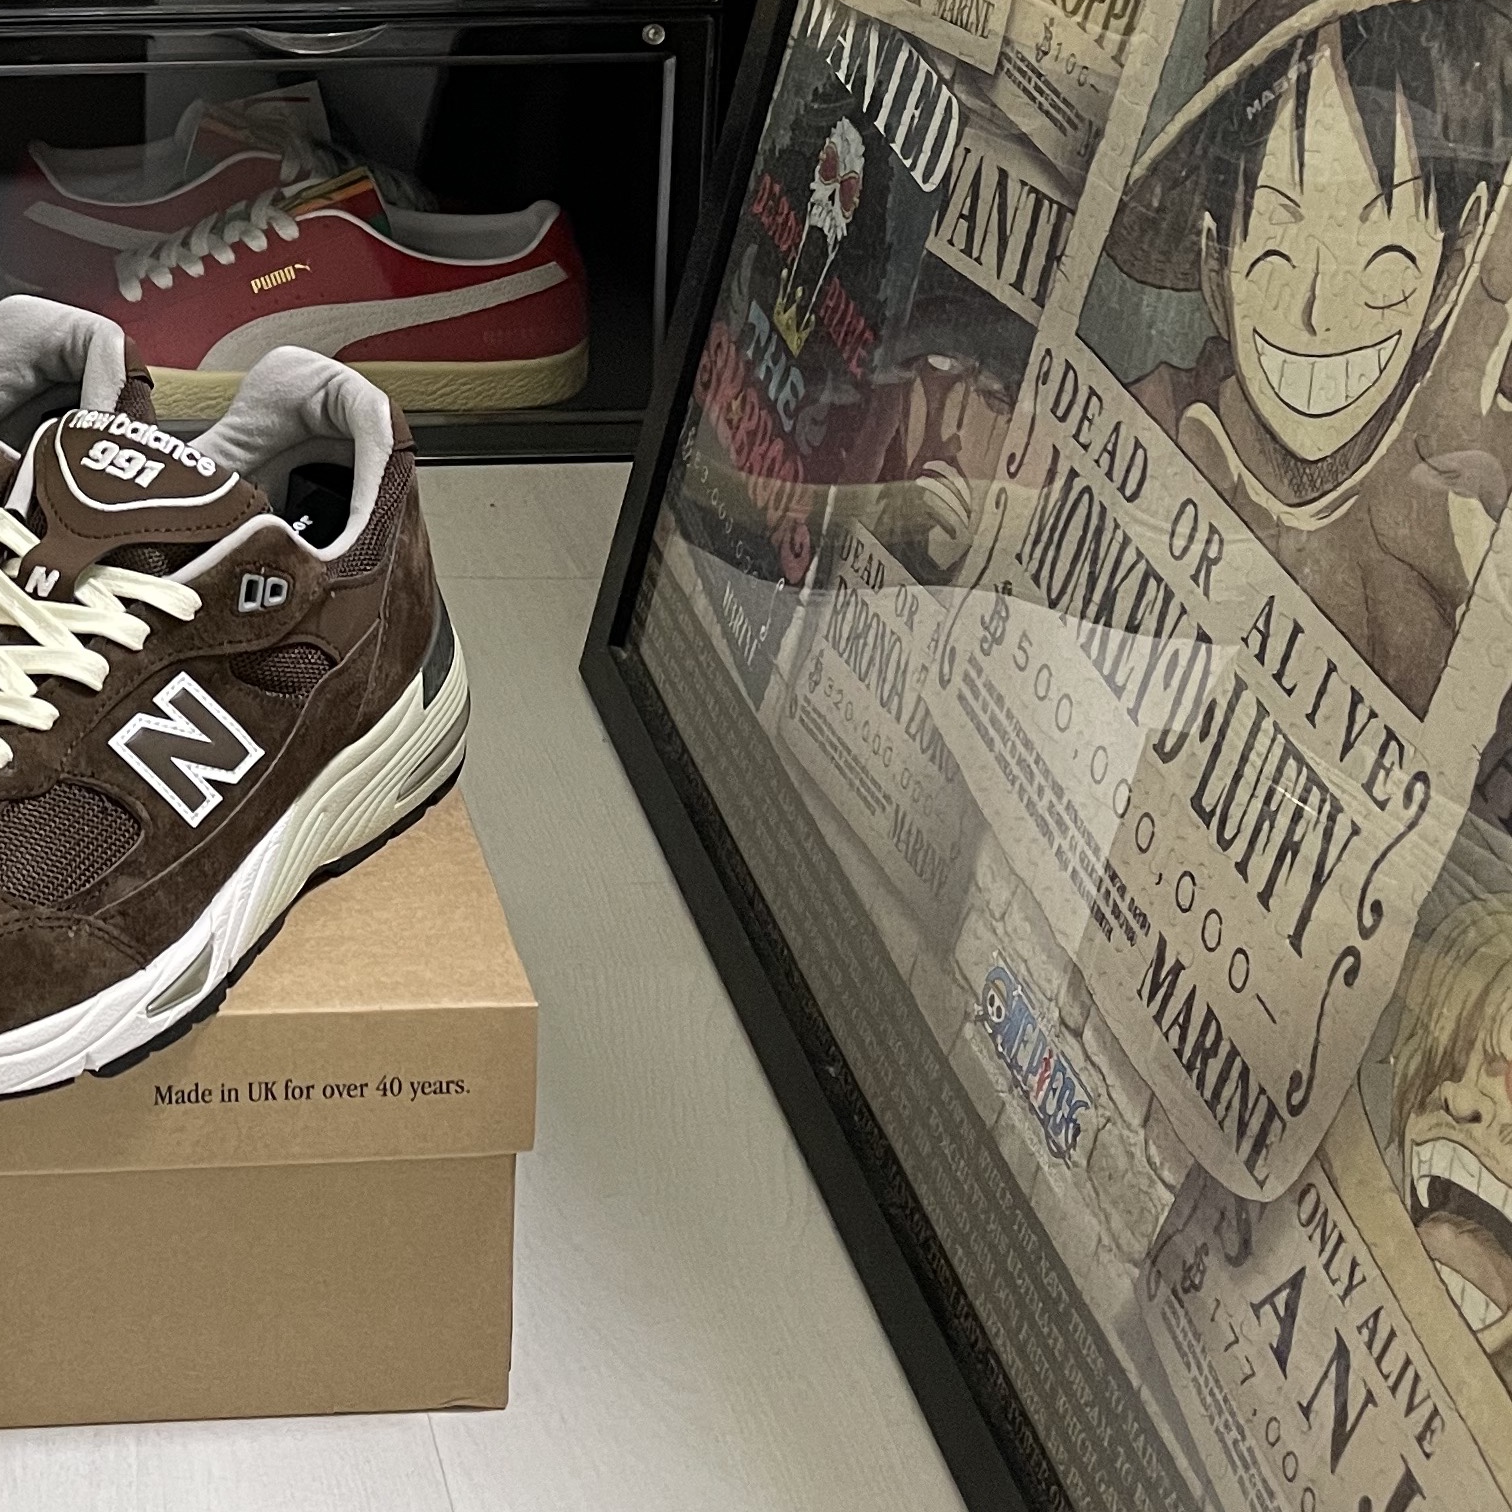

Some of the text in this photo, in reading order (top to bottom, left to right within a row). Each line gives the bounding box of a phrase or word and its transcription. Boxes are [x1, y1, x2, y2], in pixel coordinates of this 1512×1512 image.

[69, 409, 217, 477] new balance
[81, 440, 165, 488] 991
[26, 566, 60, 596] N
[895, 583, 919, 632] OR
[1050, 359, 1405, 811] DEAD OR ALIVE
[108, 671, 265, 828] N
[153, 1075, 470, 1106] Made in UK for over 40 years.
[1138, 932, 1286, 1190] MARINE
[1296, 1183, 1445, 1460] ONLY ALIVE
